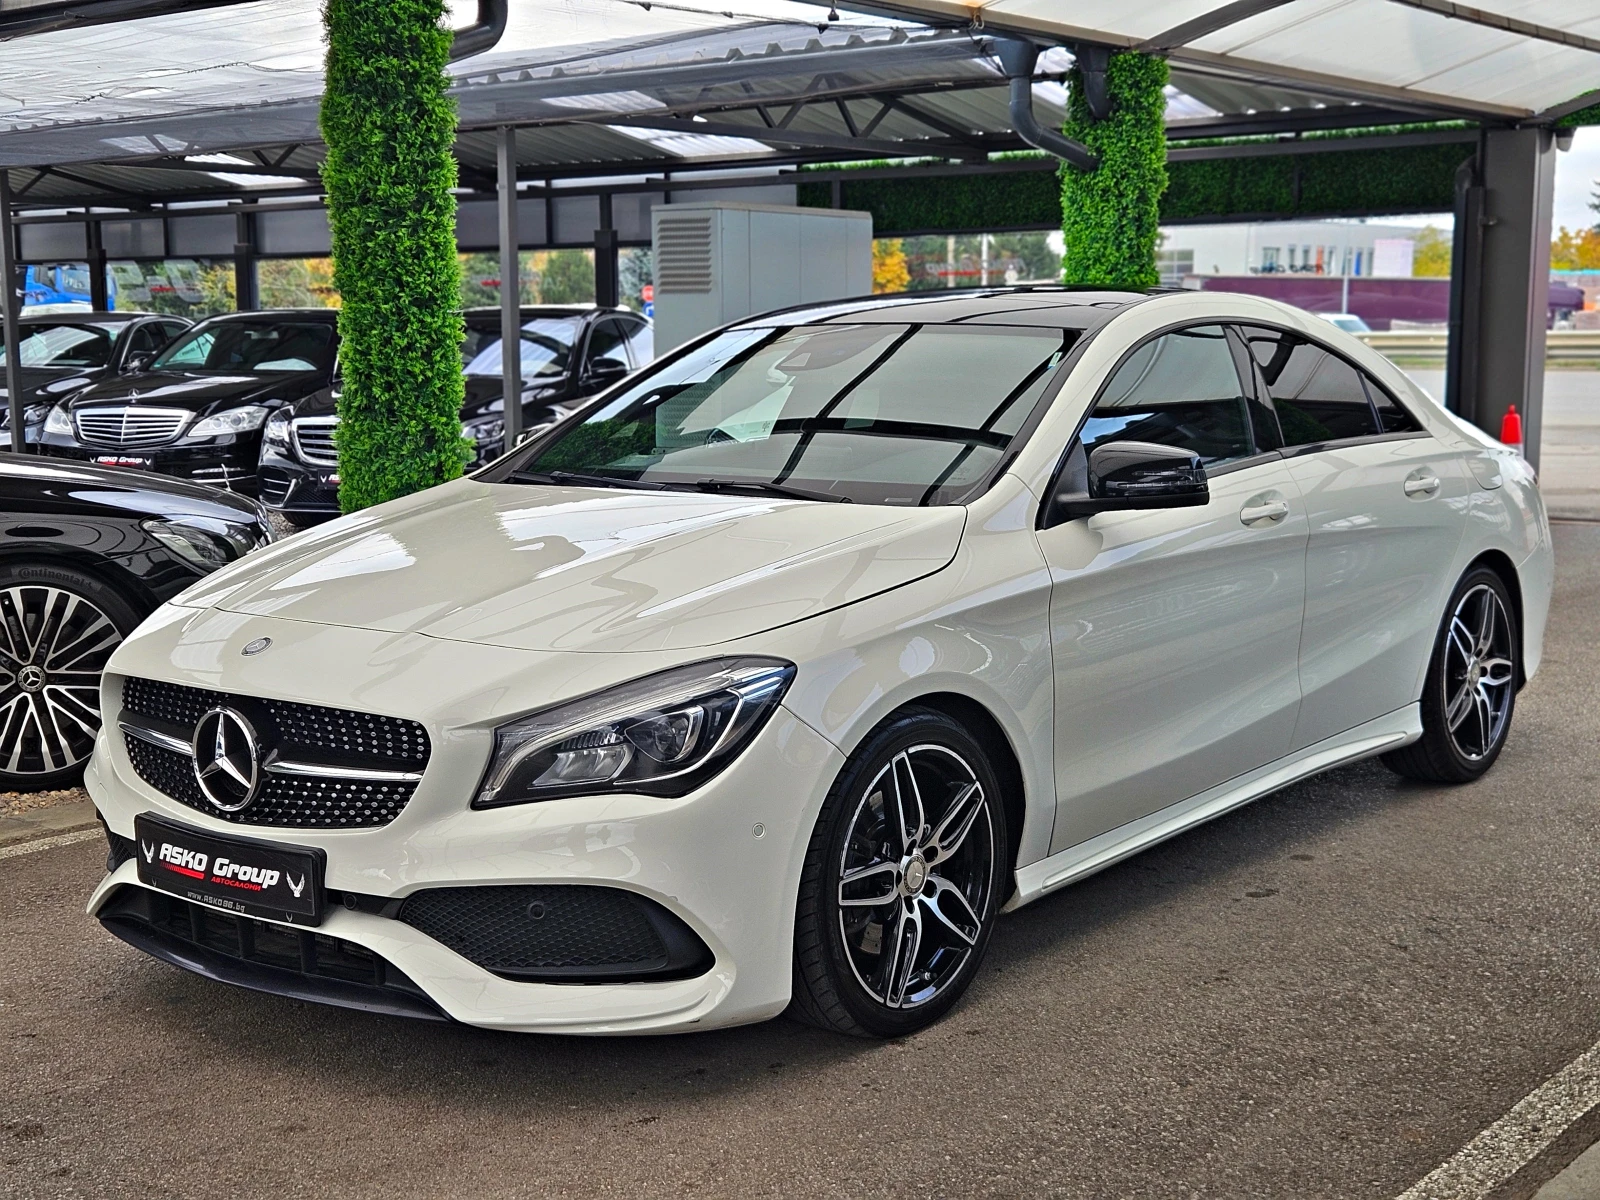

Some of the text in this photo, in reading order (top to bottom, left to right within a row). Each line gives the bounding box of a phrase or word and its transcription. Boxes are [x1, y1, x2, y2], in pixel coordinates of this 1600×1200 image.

[119, 456, 143, 464] Group
[18, 567, 86, 586] Continental
[159, 843, 280, 889] ASKO Group
[211, 876, 262, 892] АВТОСАЛОНИ
